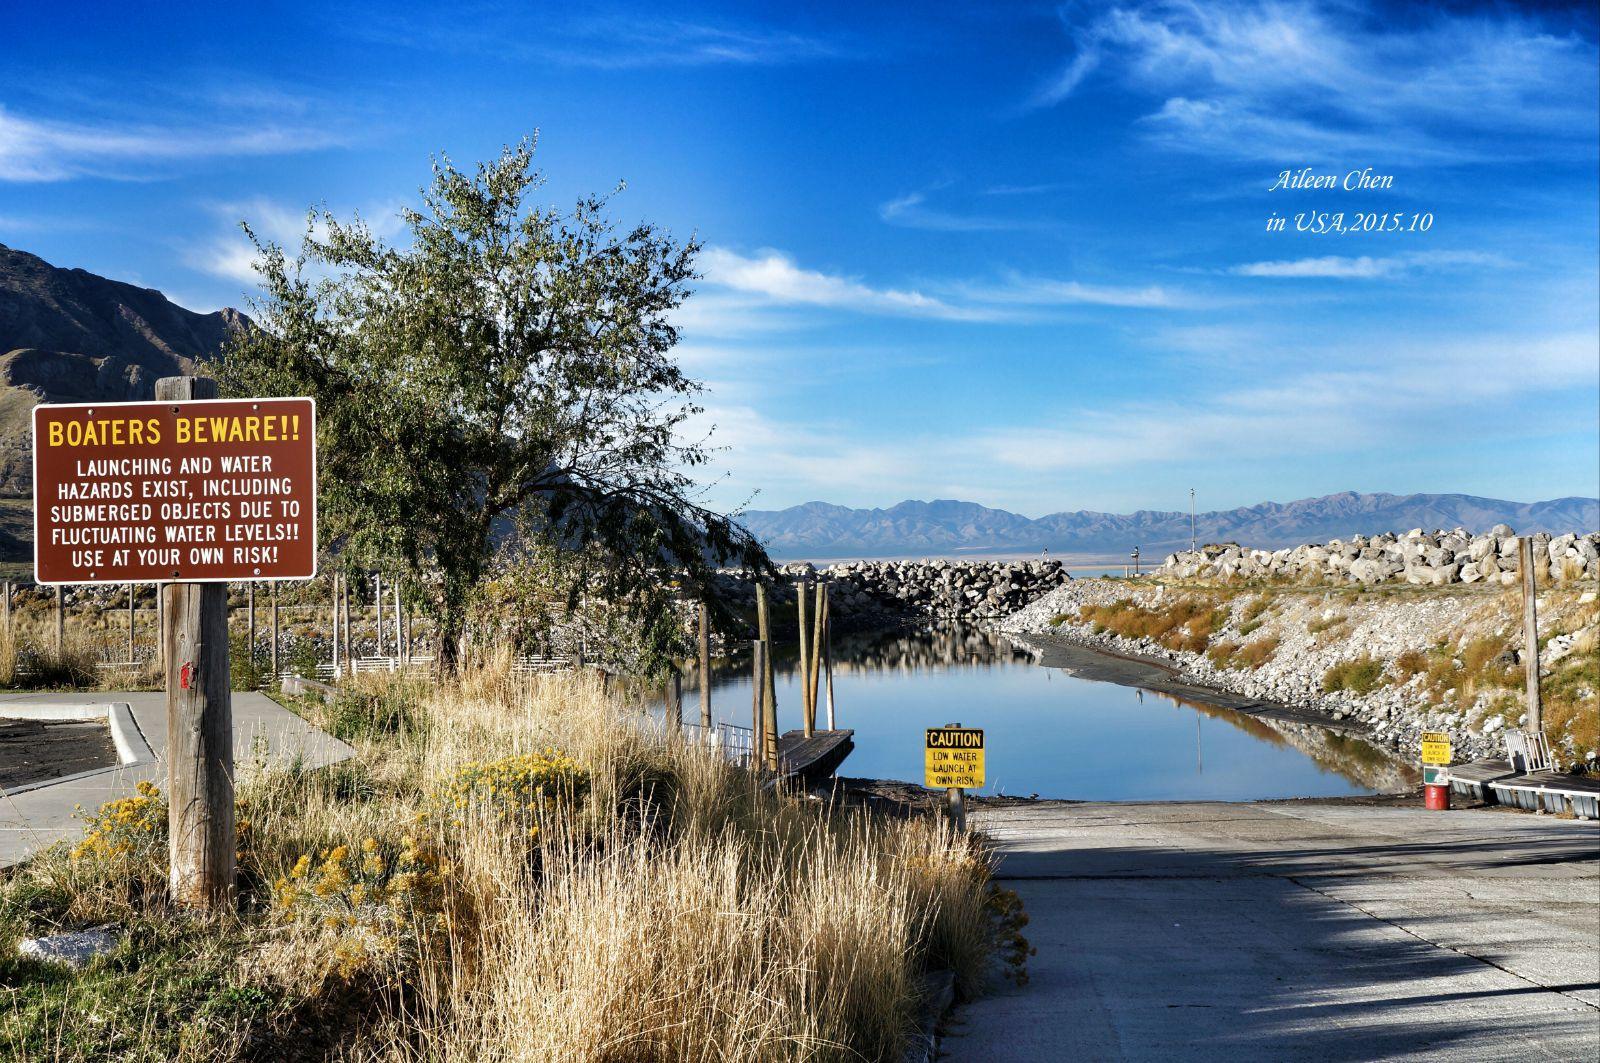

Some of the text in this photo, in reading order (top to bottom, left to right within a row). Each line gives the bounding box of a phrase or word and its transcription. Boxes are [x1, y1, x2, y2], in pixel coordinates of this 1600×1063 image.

[49, 415, 300, 447] BOATERS BEWARE!!
[77, 456, 272, 477] LAUNCHING AND WATER
[58, 478, 291, 500] HAZARDS EXIST, INCLUDING
[51, 500, 300, 523] SUBMERGED OBJECTS DUE TO
[52, 524, 299, 545] FLUCTUATING WATER LEVELS!!
[72, 547, 278, 567] USE AT YOUR OWN RISK!
[930, 732, 981, 746] CAUTION
[933, 752, 976, 761] LOW WATER
[936, 776, 974, 785] OWN RISK
